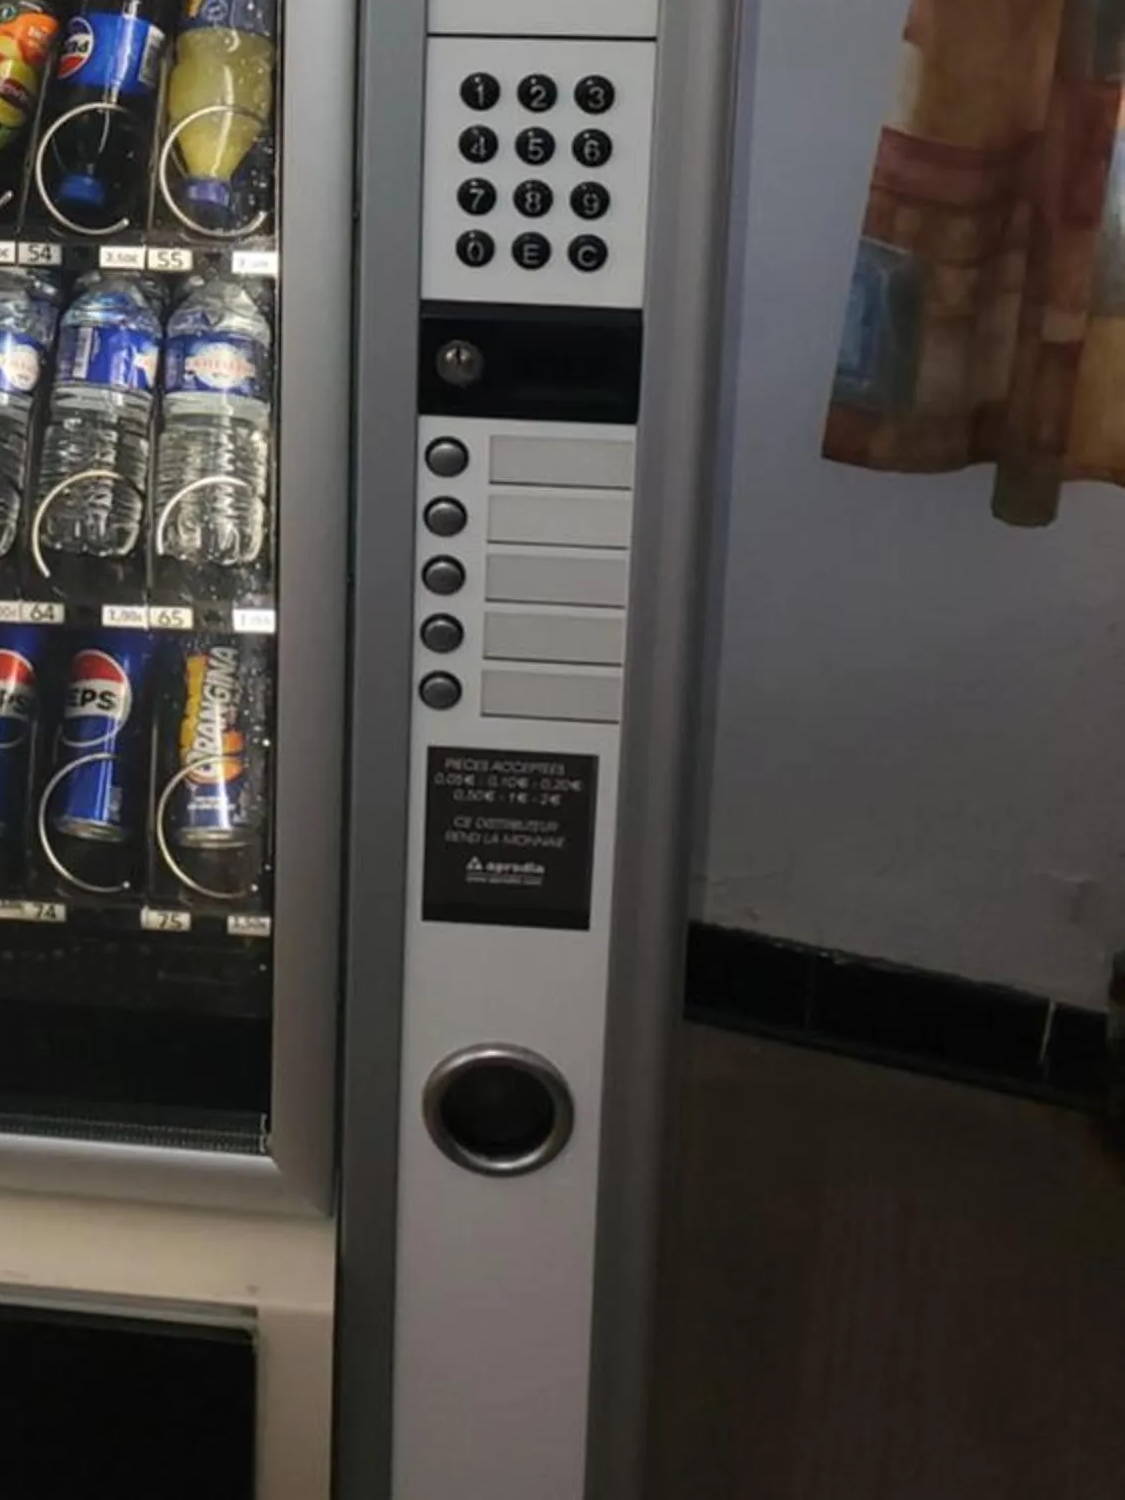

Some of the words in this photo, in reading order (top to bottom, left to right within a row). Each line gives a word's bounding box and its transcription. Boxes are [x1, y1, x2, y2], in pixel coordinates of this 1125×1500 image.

[476, 84, 485, 108] 1
[530, 85, 547, 108] 2
[588, 86, 605, 109] 3
[470, 135, 486, 157] 4
[528, 137, 544, 161] 5
[584, 139, 600, 162] 6
[469, 188, 485, 211] 7
[525, 190, 541, 213] 8
[583, 192, 600, 215] 9
[28, 244, 52, 262] 54
[156, 251, 183, 269] 55
[467, 240, 484, 262] 0
[523, 243, 540, 265] E
[577, 245, 597, 267] C
[29, 604, 54, 622] 64
[158, 609, 184, 628] 65
[186, 646, 239, 779] ORANGINA
[159, 913, 182, 929] 75
